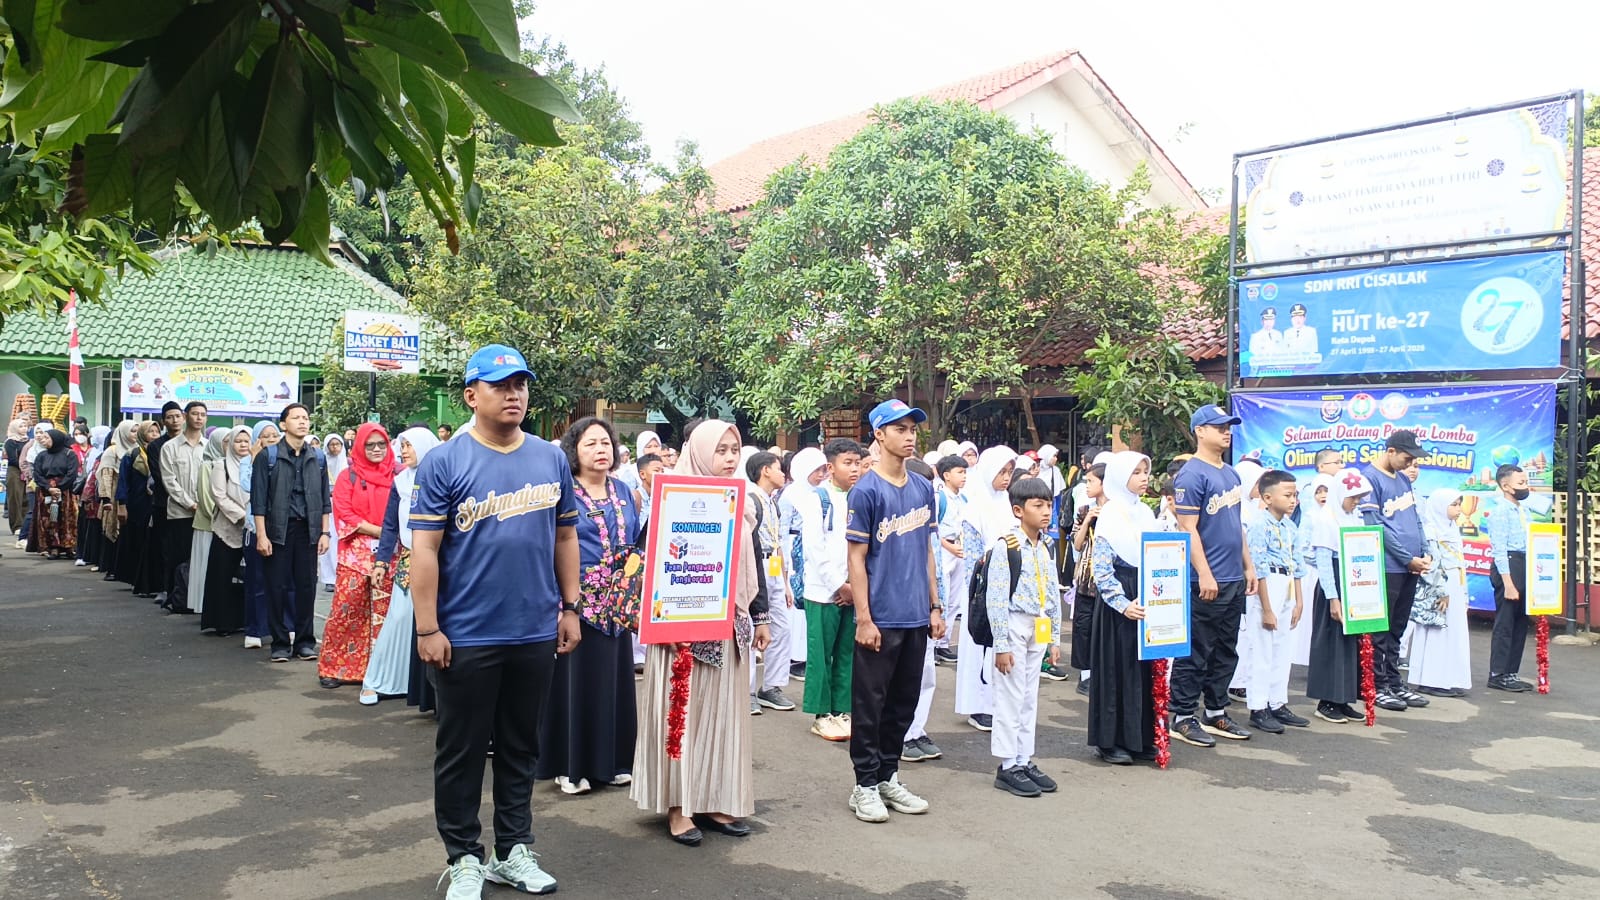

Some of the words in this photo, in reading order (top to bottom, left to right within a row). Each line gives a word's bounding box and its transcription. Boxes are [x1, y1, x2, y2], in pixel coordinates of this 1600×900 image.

[1303, 279, 1333, 294] SDN
[1335, 275, 1360, 292] RRI
[1362, 270, 1428, 289] CISALAK
[1331, 314, 1373, 333] HUT
[1375, 310, 1431, 331] ke-27
[1472, 288, 1525, 346] 27
[347, 332, 390, 348] BASKET
[391, 337, 418, 350] BALL
[1350, 334, 1377, 345] Depok
[1339, 347, 1357, 356] April
[1379, 345, 1388, 354] 27
[1388, 344, 1406, 354] April
[179, 366, 213, 375] SELAMAT
[213, 366, 244, 377] DATANG
[188, 374, 234, 385] Peserta
[1284, 427, 1333, 443] Selamat
[1335, 424, 1380, 441] Datang
[1430, 424, 1475, 443] Lomba
[1284, 444, 1357, 468] Olimde
[1416, 447, 1474, 470] asional
[455, 482, 561, 532] Sukmajaya
[671, 521, 722, 534] KONTINGEN
[664, 562, 682, 574] Team
[716, 562, 724, 573] &
[671, 574, 714, 586] Pengkoreksi
